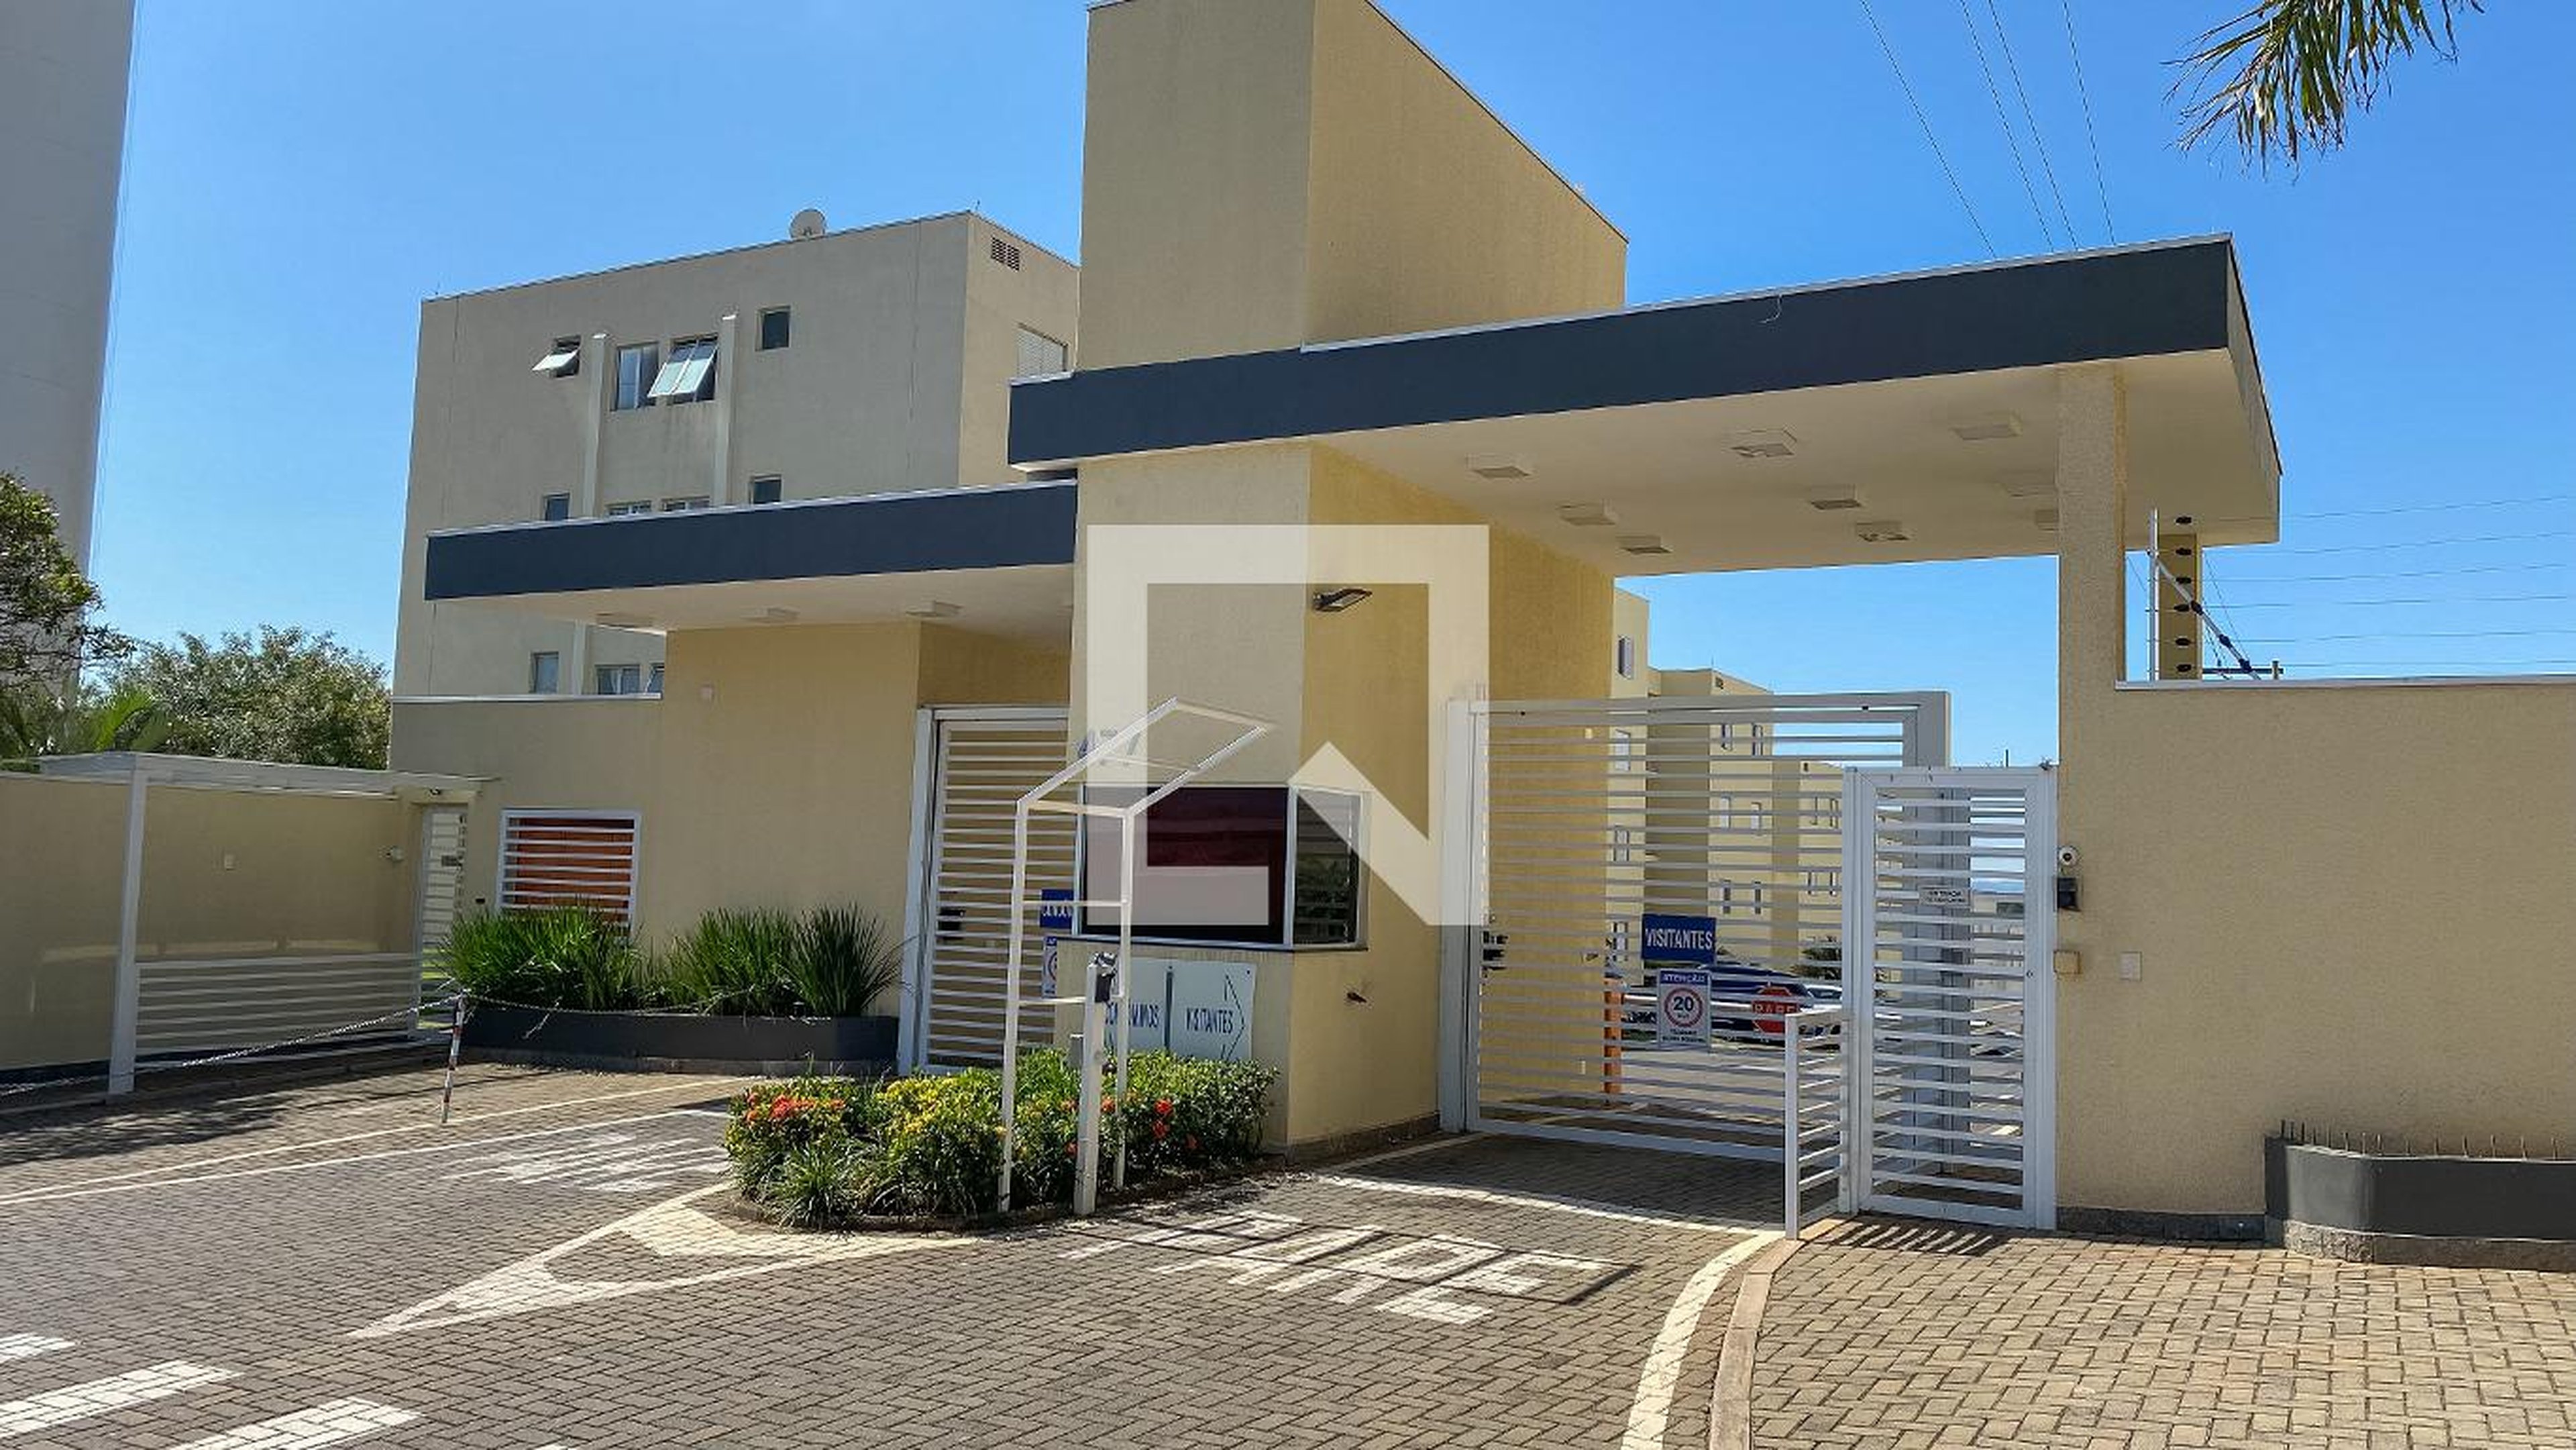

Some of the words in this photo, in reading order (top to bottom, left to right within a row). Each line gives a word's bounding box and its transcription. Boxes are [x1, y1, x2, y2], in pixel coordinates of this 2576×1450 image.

[1645, 927, 1713, 950] VISITANTES
[1673, 996, 1695, 1012] 20
[1186, 1007, 1233, 1034] VISITANTES
